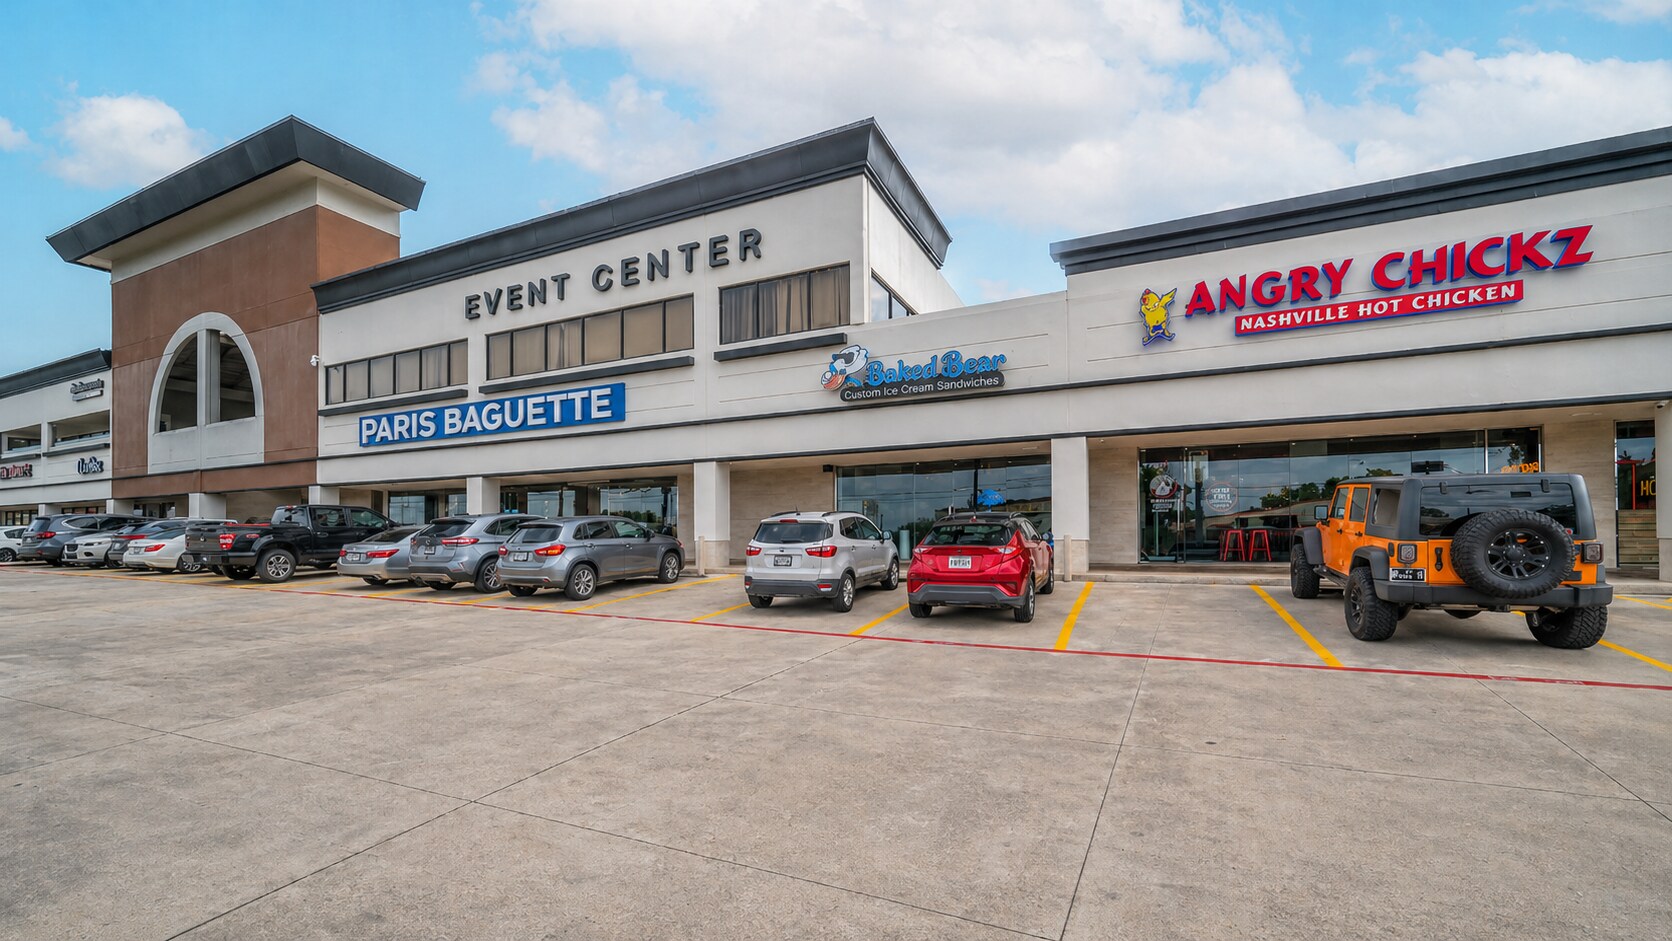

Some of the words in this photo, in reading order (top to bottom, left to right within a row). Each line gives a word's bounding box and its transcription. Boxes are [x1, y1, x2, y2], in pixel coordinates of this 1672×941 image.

[464, 272, 571, 320] EVENT
[591, 227, 763, 292] CENTER
[1185, 258, 1353, 318] ANGRY
[1371, 224, 1594, 292] CHICKZ
[1240, 305, 1349, 331] NASHVILLE
[1358, 298, 1403, 317] HOT
[1412, 283, 1516, 310] CHICKEN
[844, 387, 881, 400] Custom
[883, 386, 899, 397] Ice
[901, 381, 934, 395] Cream
[937, 375, 999, 392] Sandwiches
[866, 354, 938, 387] Baked
[941, 350, 1007, 378] Bear
[361, 411, 437, 444] PARIS
[444, 387, 613, 436] BAGUETTE
